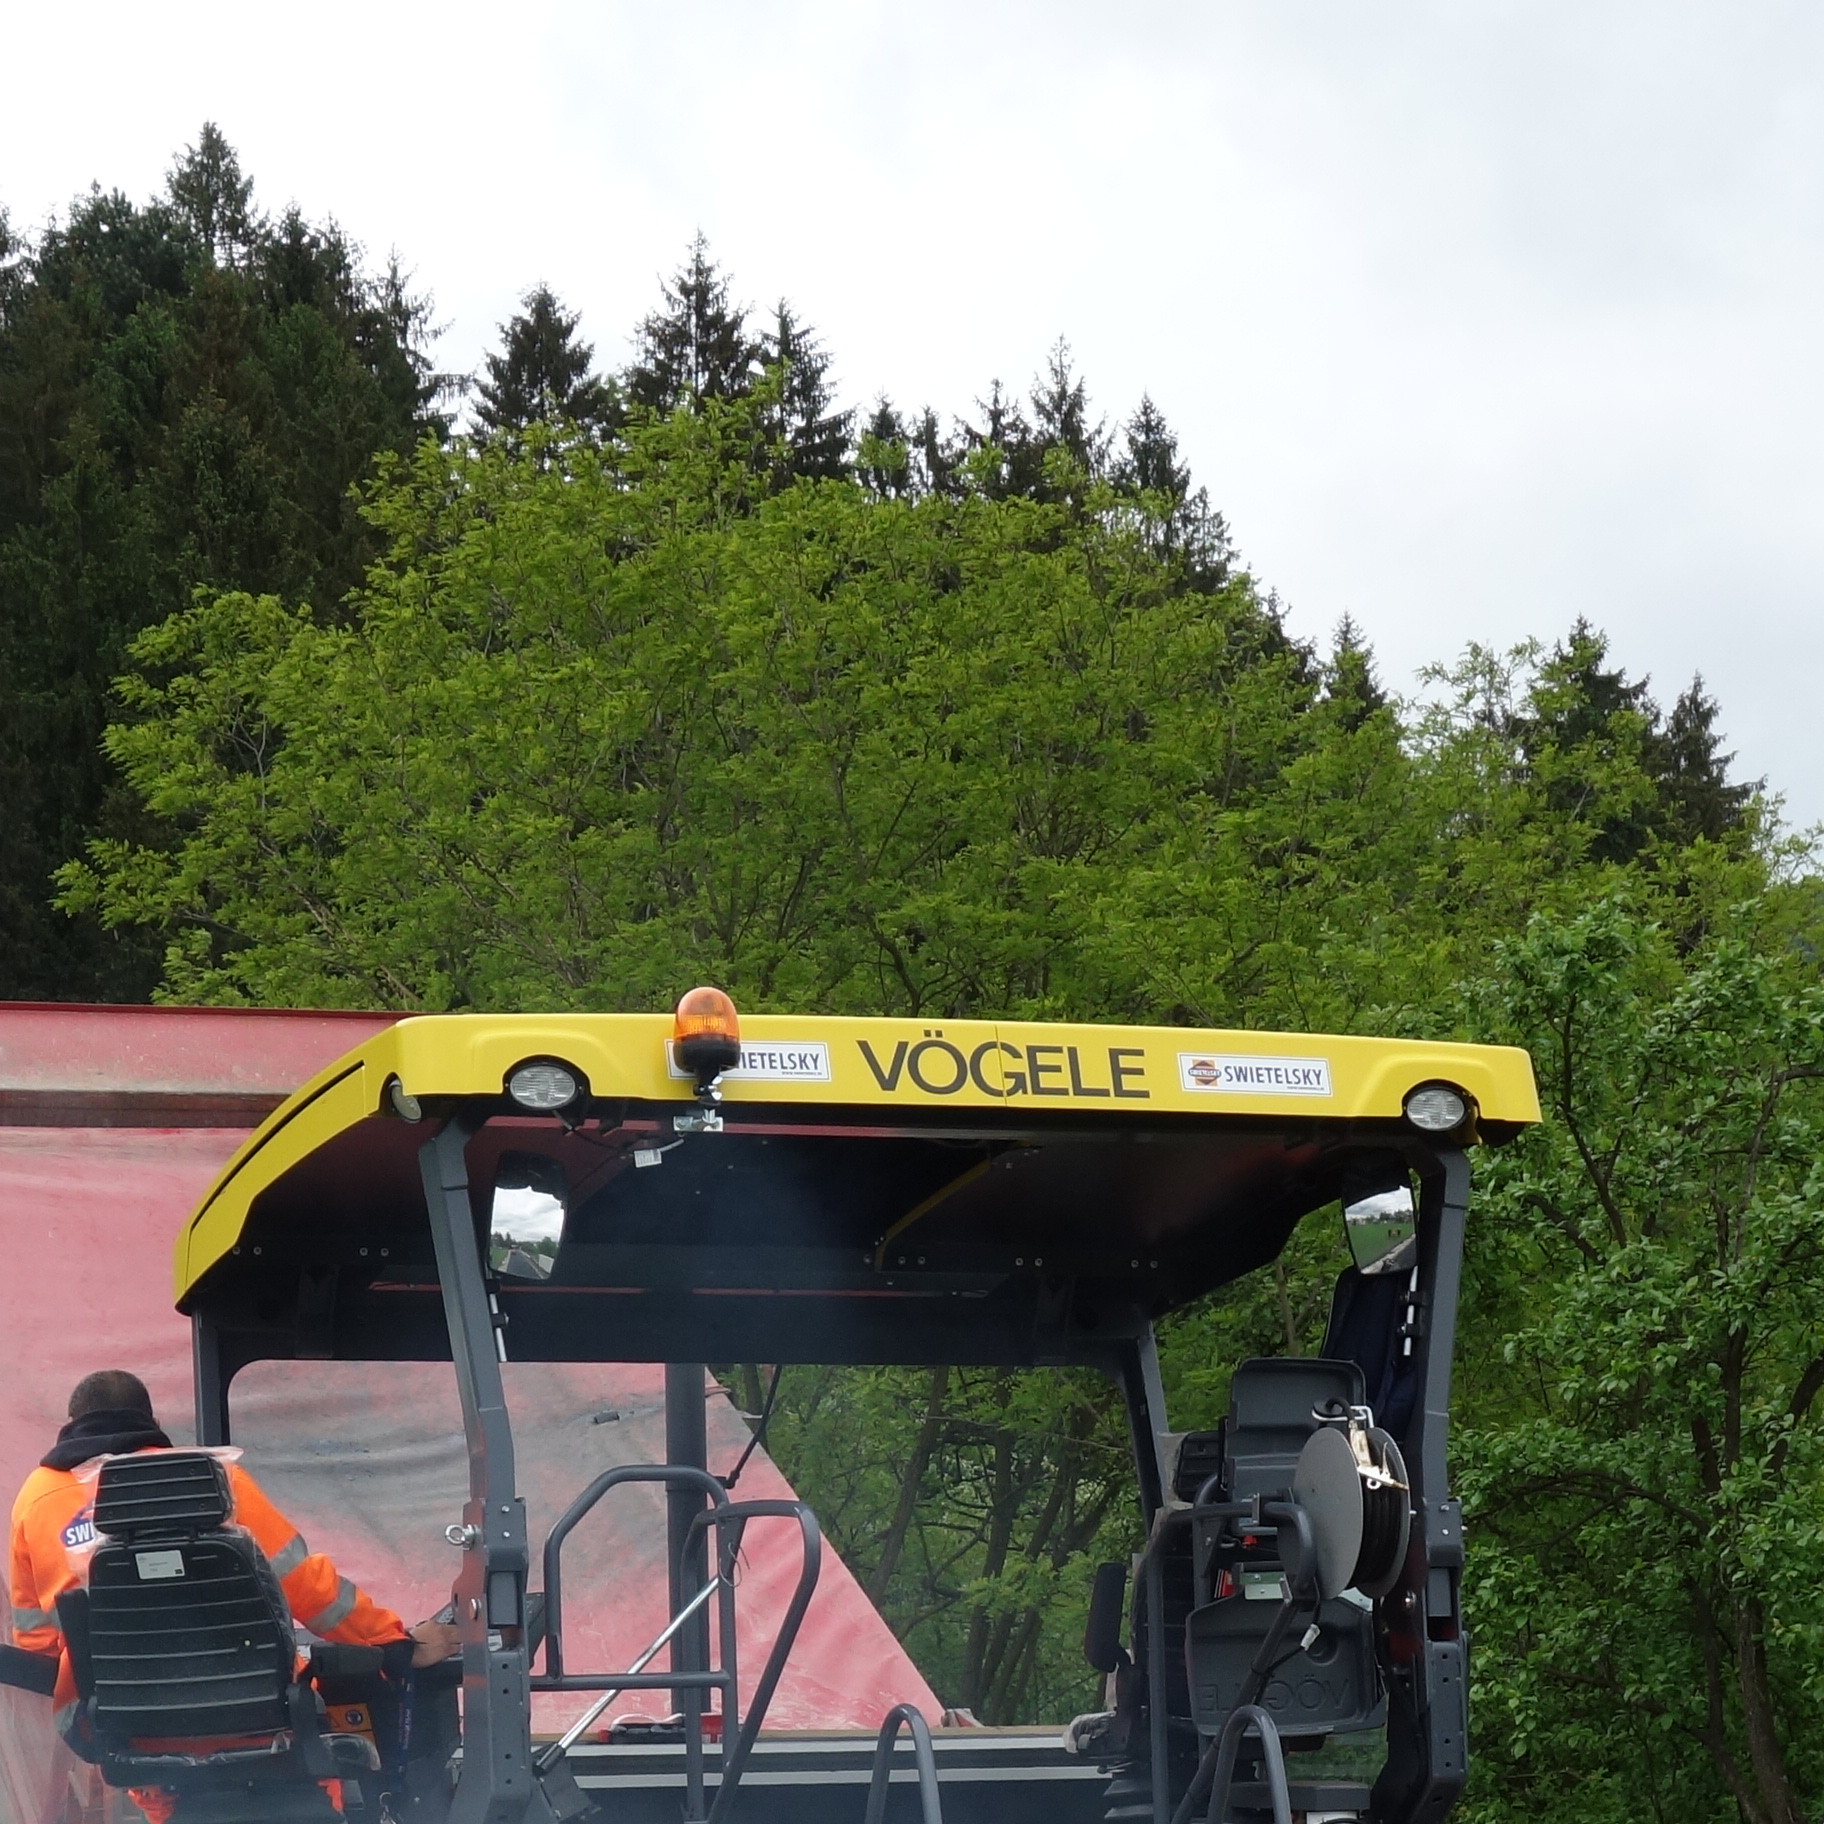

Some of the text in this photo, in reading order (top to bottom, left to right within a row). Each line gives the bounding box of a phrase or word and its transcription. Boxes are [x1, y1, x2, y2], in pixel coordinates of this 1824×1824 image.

[736, 1052, 820, 1071] IETELSKY
[856, 1029, 1151, 1098] VÖGELE
[1224, 1065, 1323, 1086] SWIETELSKY
